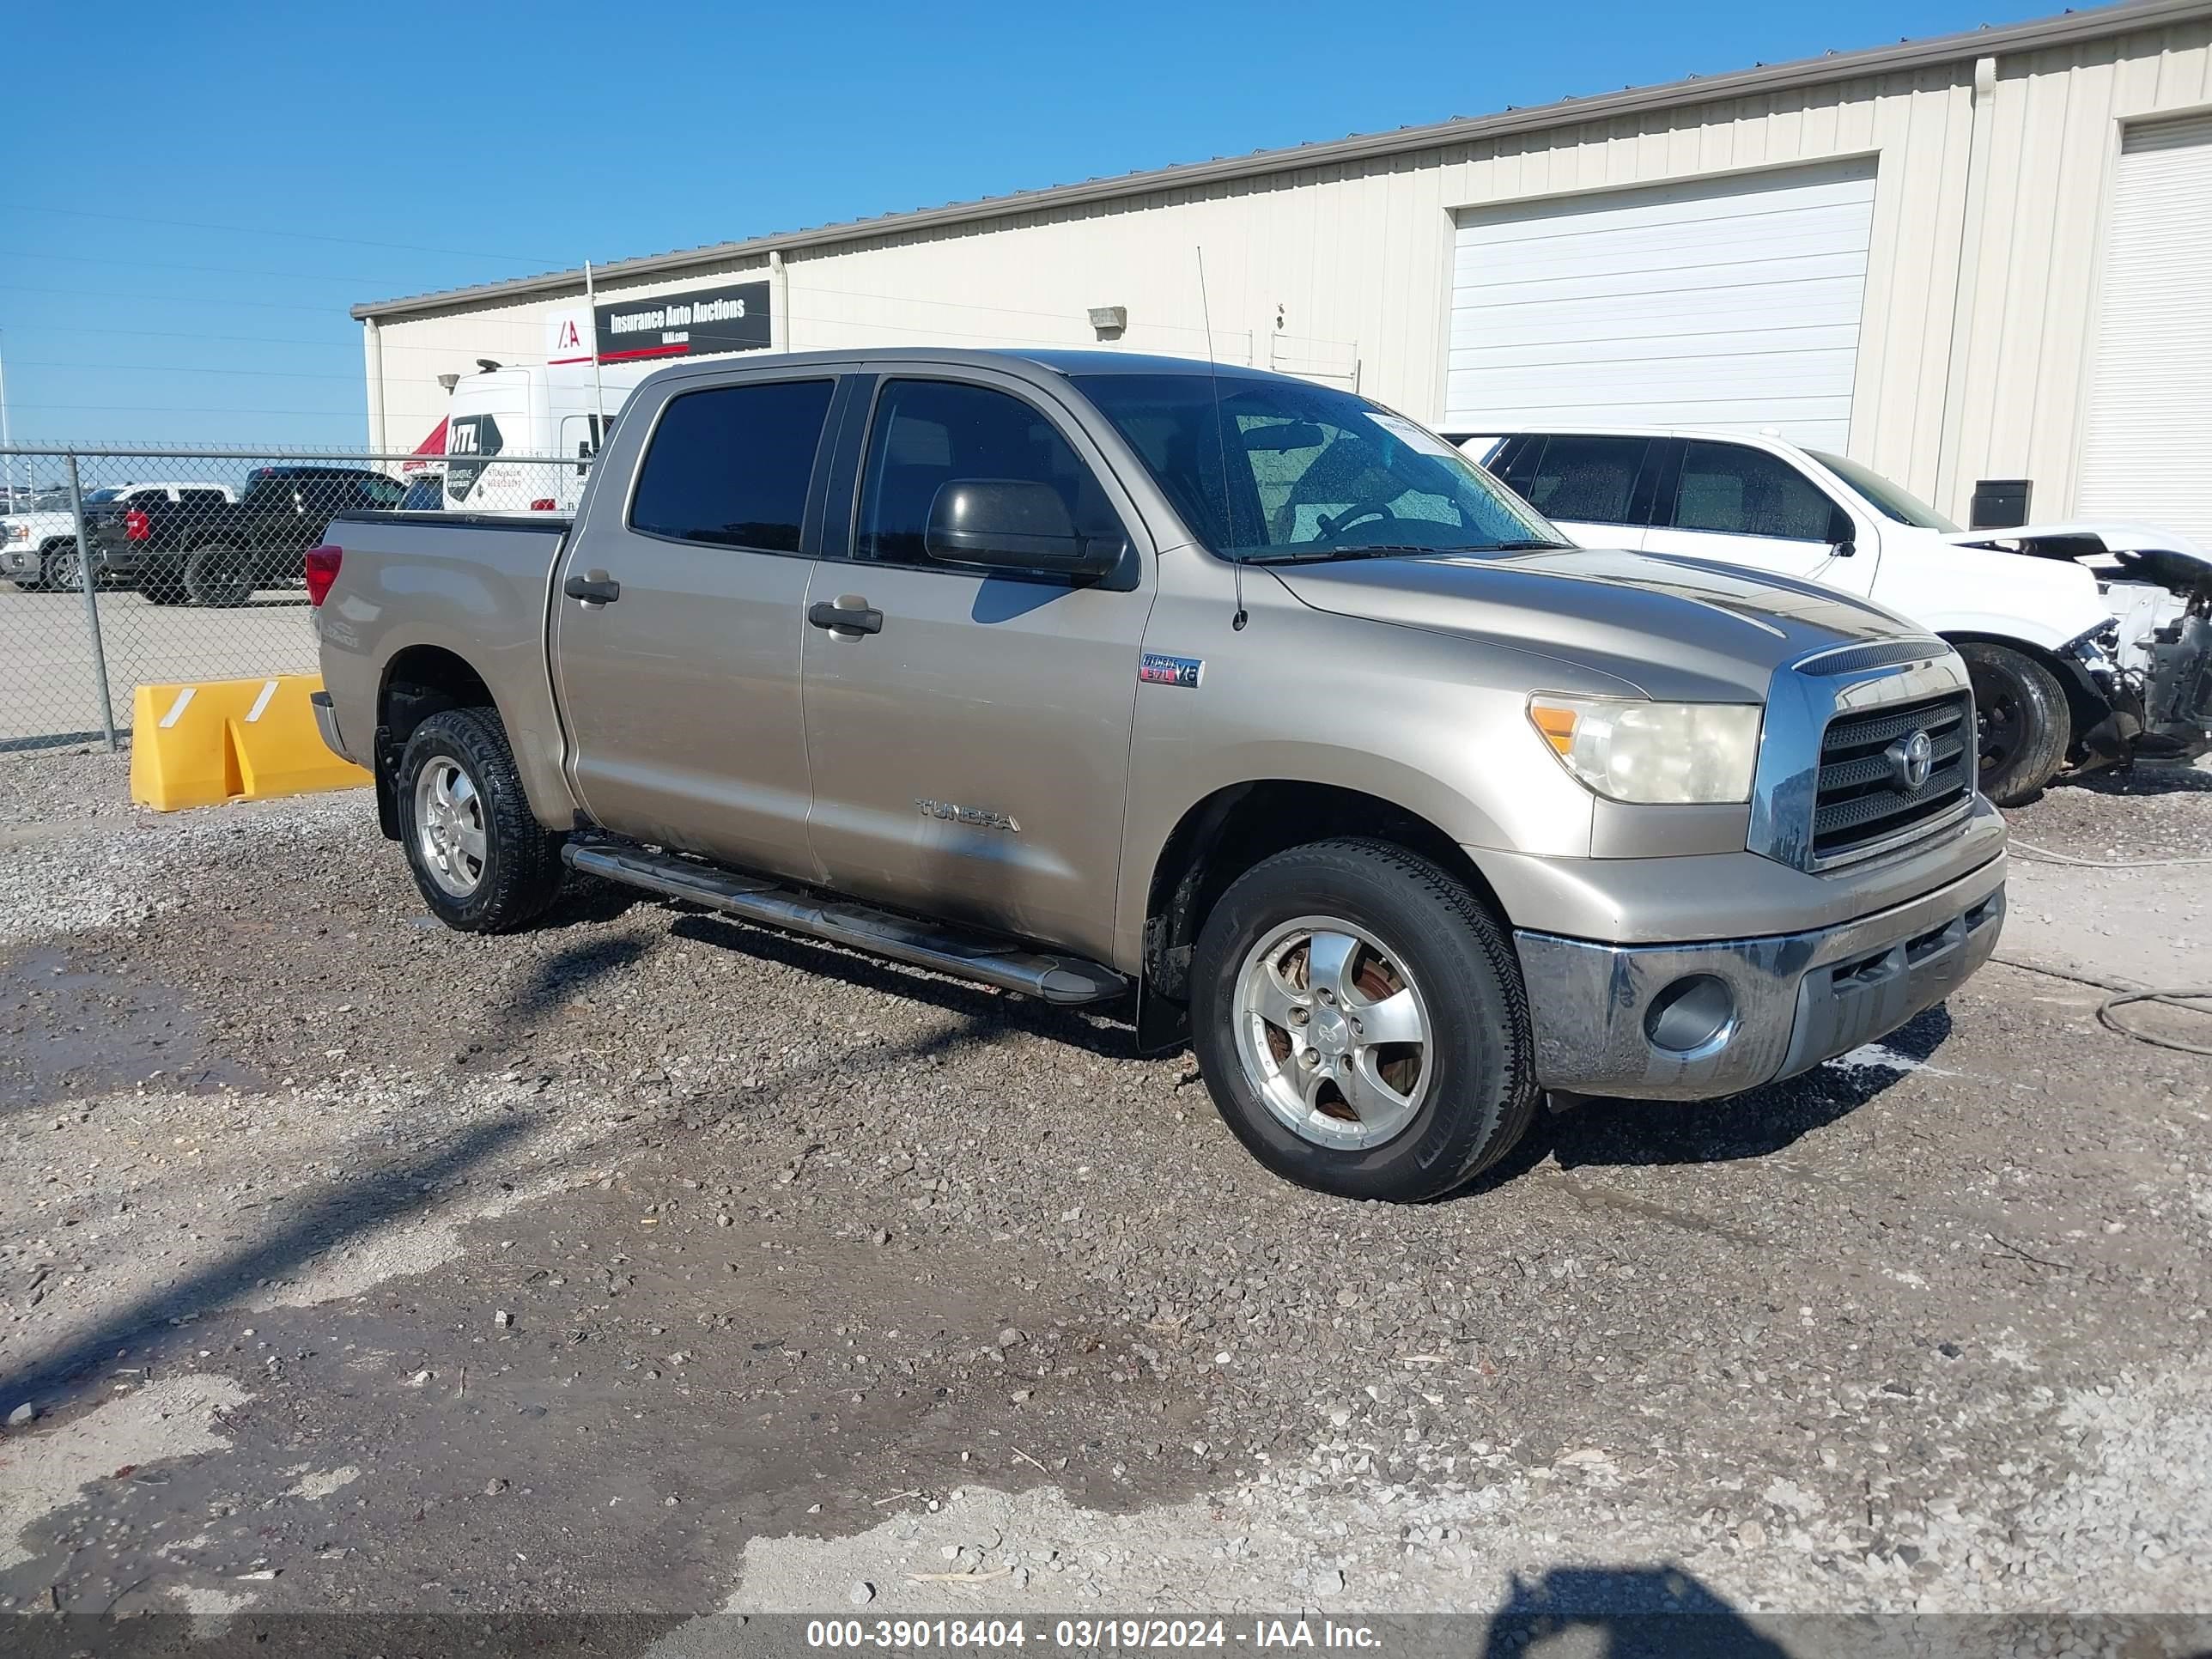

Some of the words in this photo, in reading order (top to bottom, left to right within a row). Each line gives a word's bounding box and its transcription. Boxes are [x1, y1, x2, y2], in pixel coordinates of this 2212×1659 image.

[611, 310, 665, 334] Insurance
[665, 305, 692, 327] Auto
[693, 298, 745, 324] Auctions
[1176, 664, 1199, 682] V8
[915, 797, 1022, 832] TUNDRA
